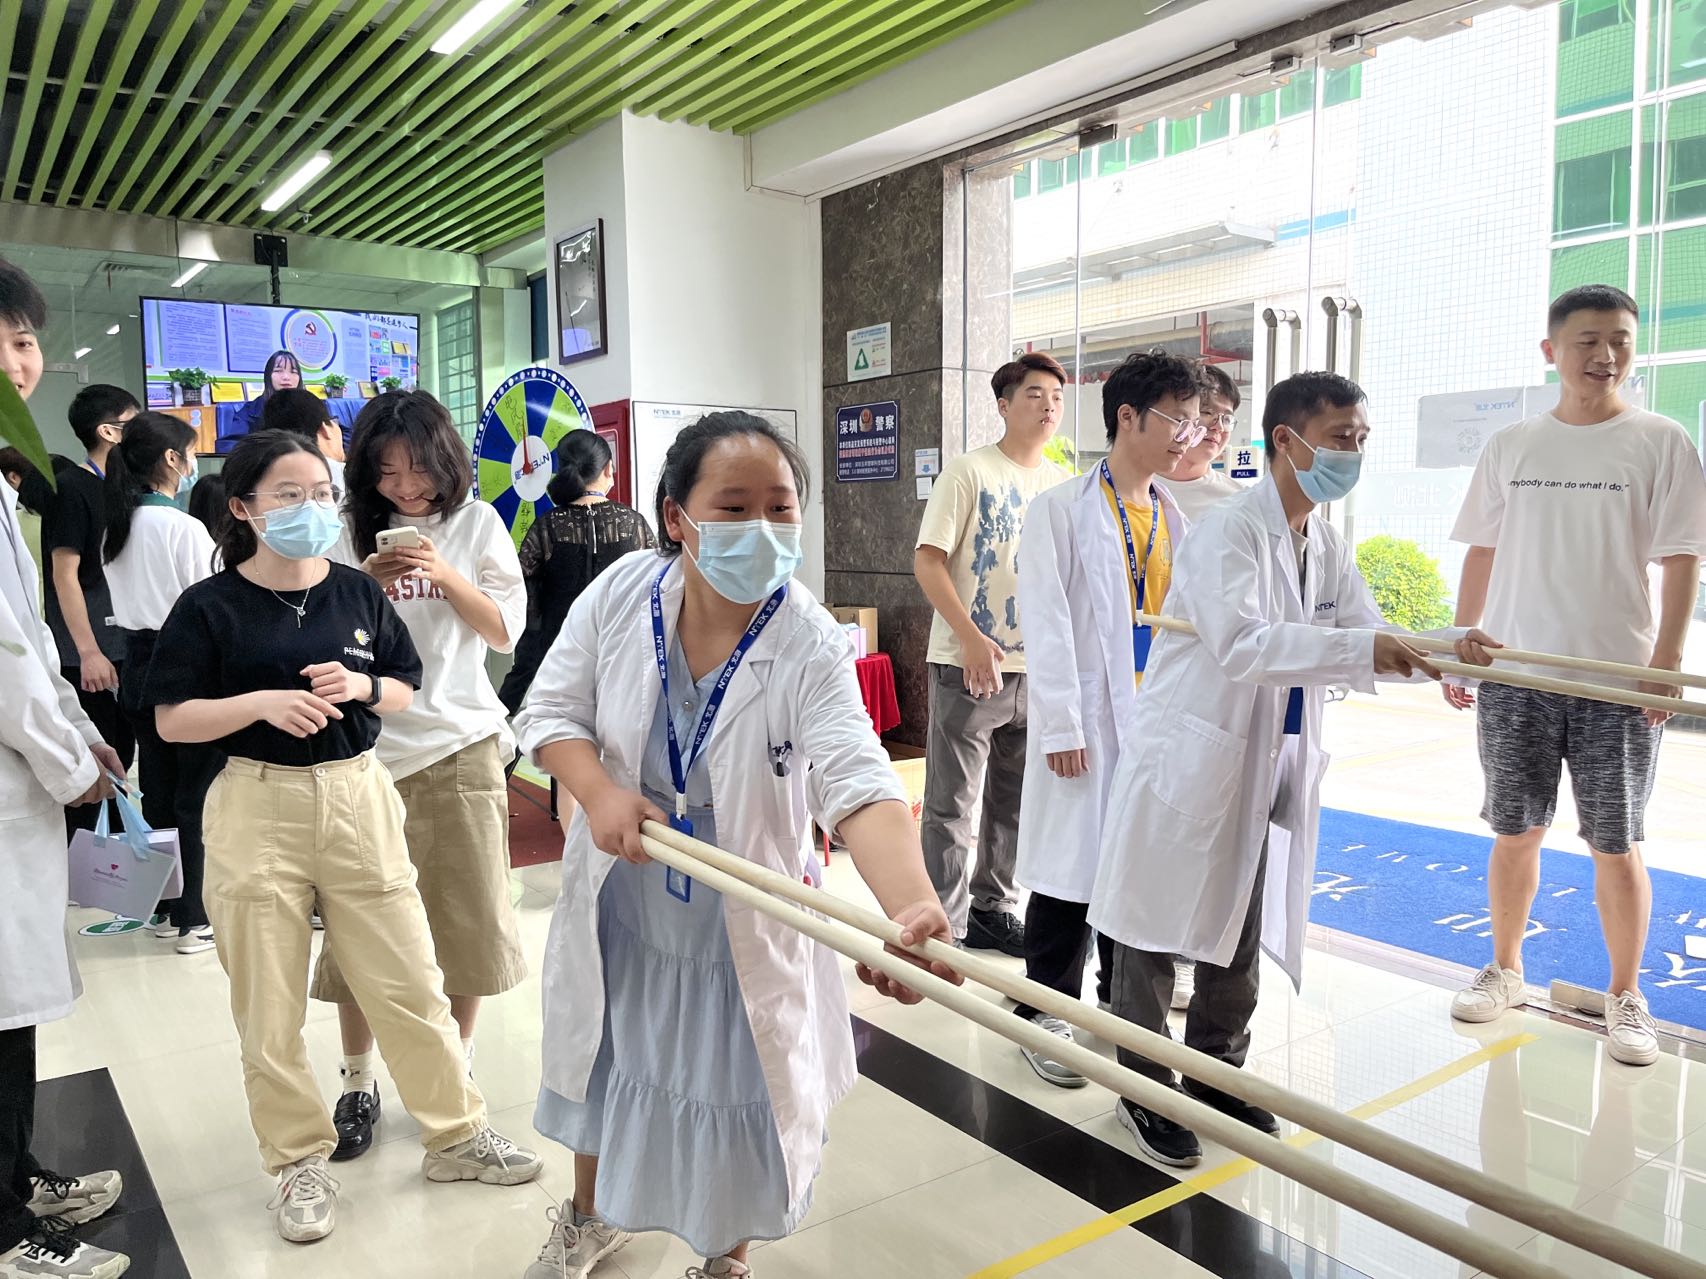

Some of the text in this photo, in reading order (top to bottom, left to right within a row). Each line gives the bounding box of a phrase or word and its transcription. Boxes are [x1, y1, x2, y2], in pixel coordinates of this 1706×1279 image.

[840, 415, 895, 434] 深圳 警察
[1237, 450, 1251, 466] 拉
[1508, 479, 1542, 488] nybody
[1579, 481, 1602, 489] what
[1315, 601, 1336, 612] NTEK
[748, 613, 769, 636] NTEK
[656, 635, 665, 662] NTEK
[718, 665, 735, 690] NTEK
[695, 720, 710, 745] NTEK
